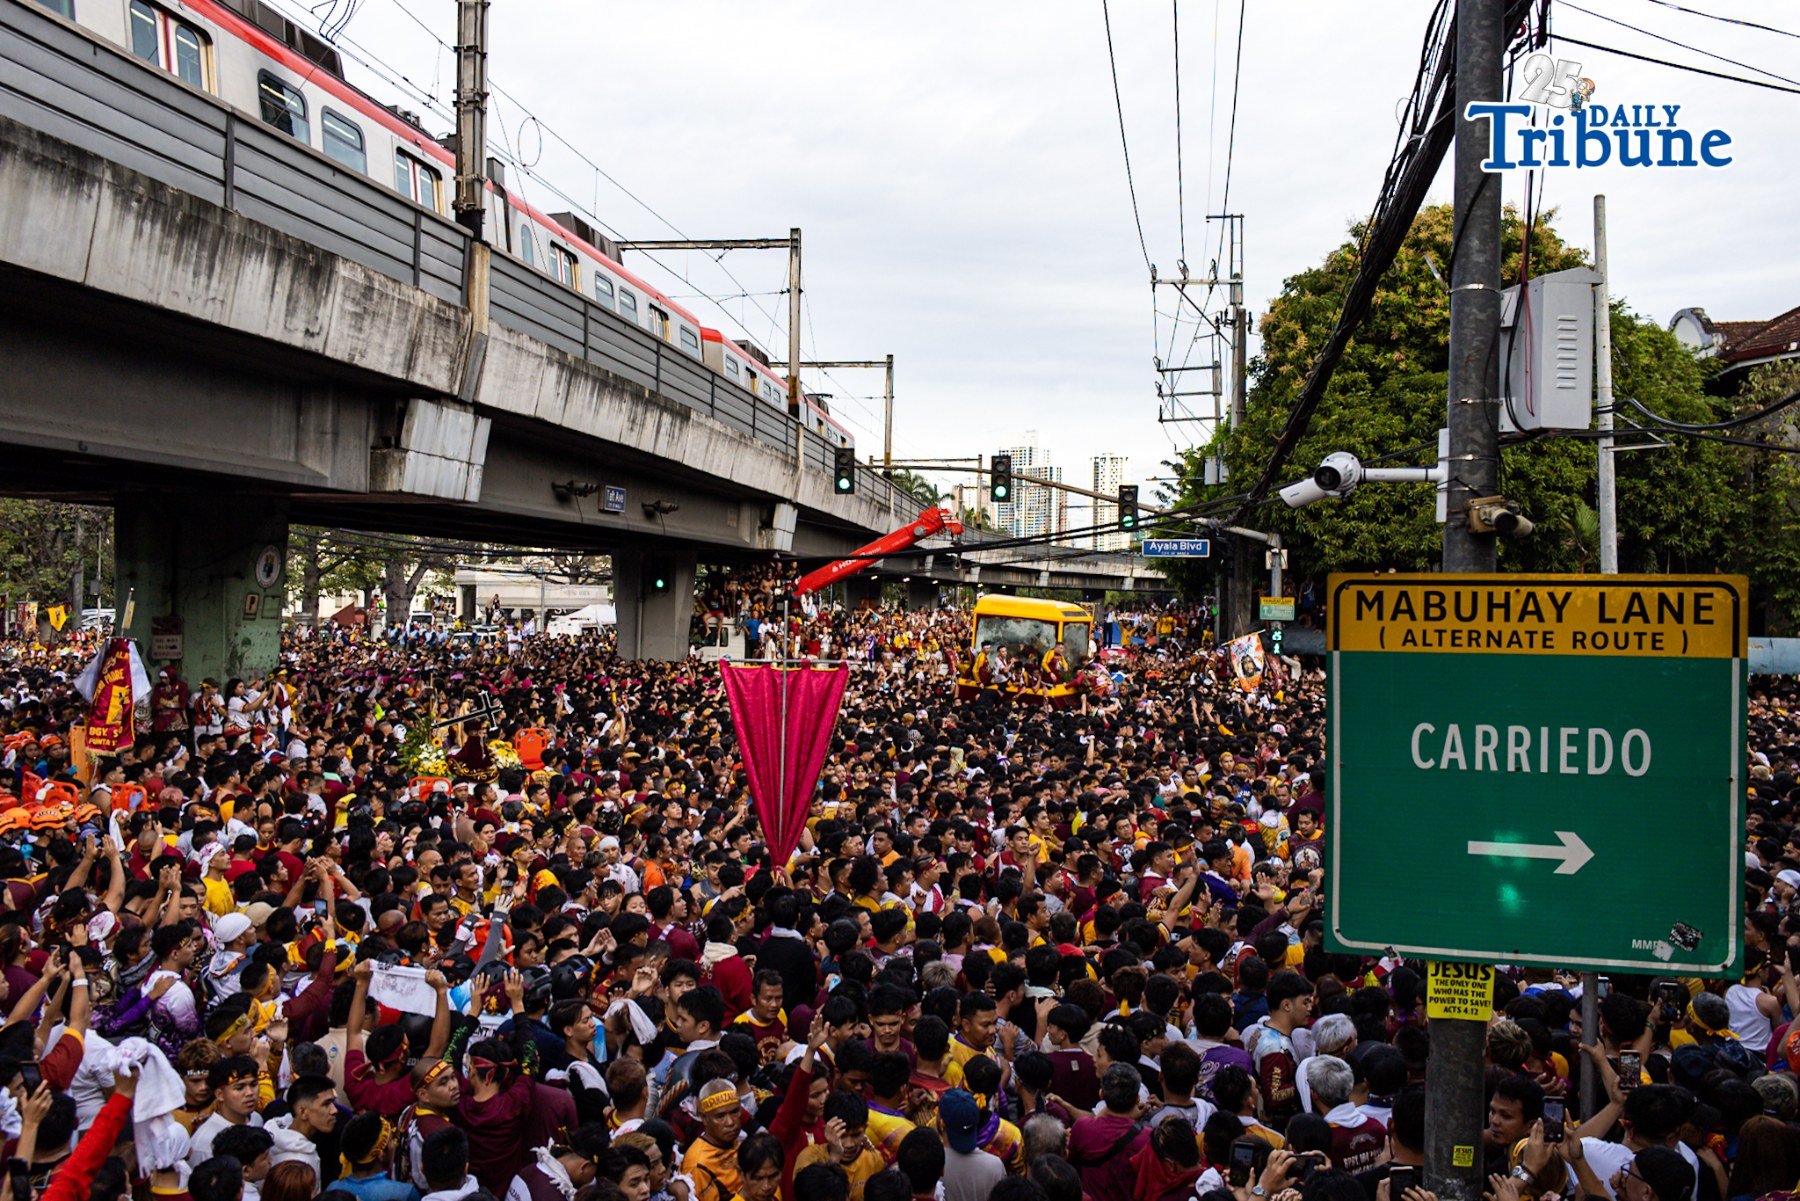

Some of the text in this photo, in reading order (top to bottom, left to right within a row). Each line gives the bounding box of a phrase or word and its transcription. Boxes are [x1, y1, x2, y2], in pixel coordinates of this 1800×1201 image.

[1149, 541, 1203, 553] Ayala Blvd
[1355, 590, 1715, 625] MABUHAY LANE
[1401, 628, 1556, 650] ALTERNATE
[1572, 630, 1665, 652] ROUTE
[1411, 722, 1652, 777] CARRIEDO
[1430, 961, 1492, 981] JESUS
[1471, 982, 1488, 990] ONE
[1433, 987, 1487, 999] WHO HAS THE
[1429, 996, 1456, 1004] POWER
[1470, 999, 1491, 1008] SAVE!
[1443, 1006, 1479, 1015] ACTS 4:12
